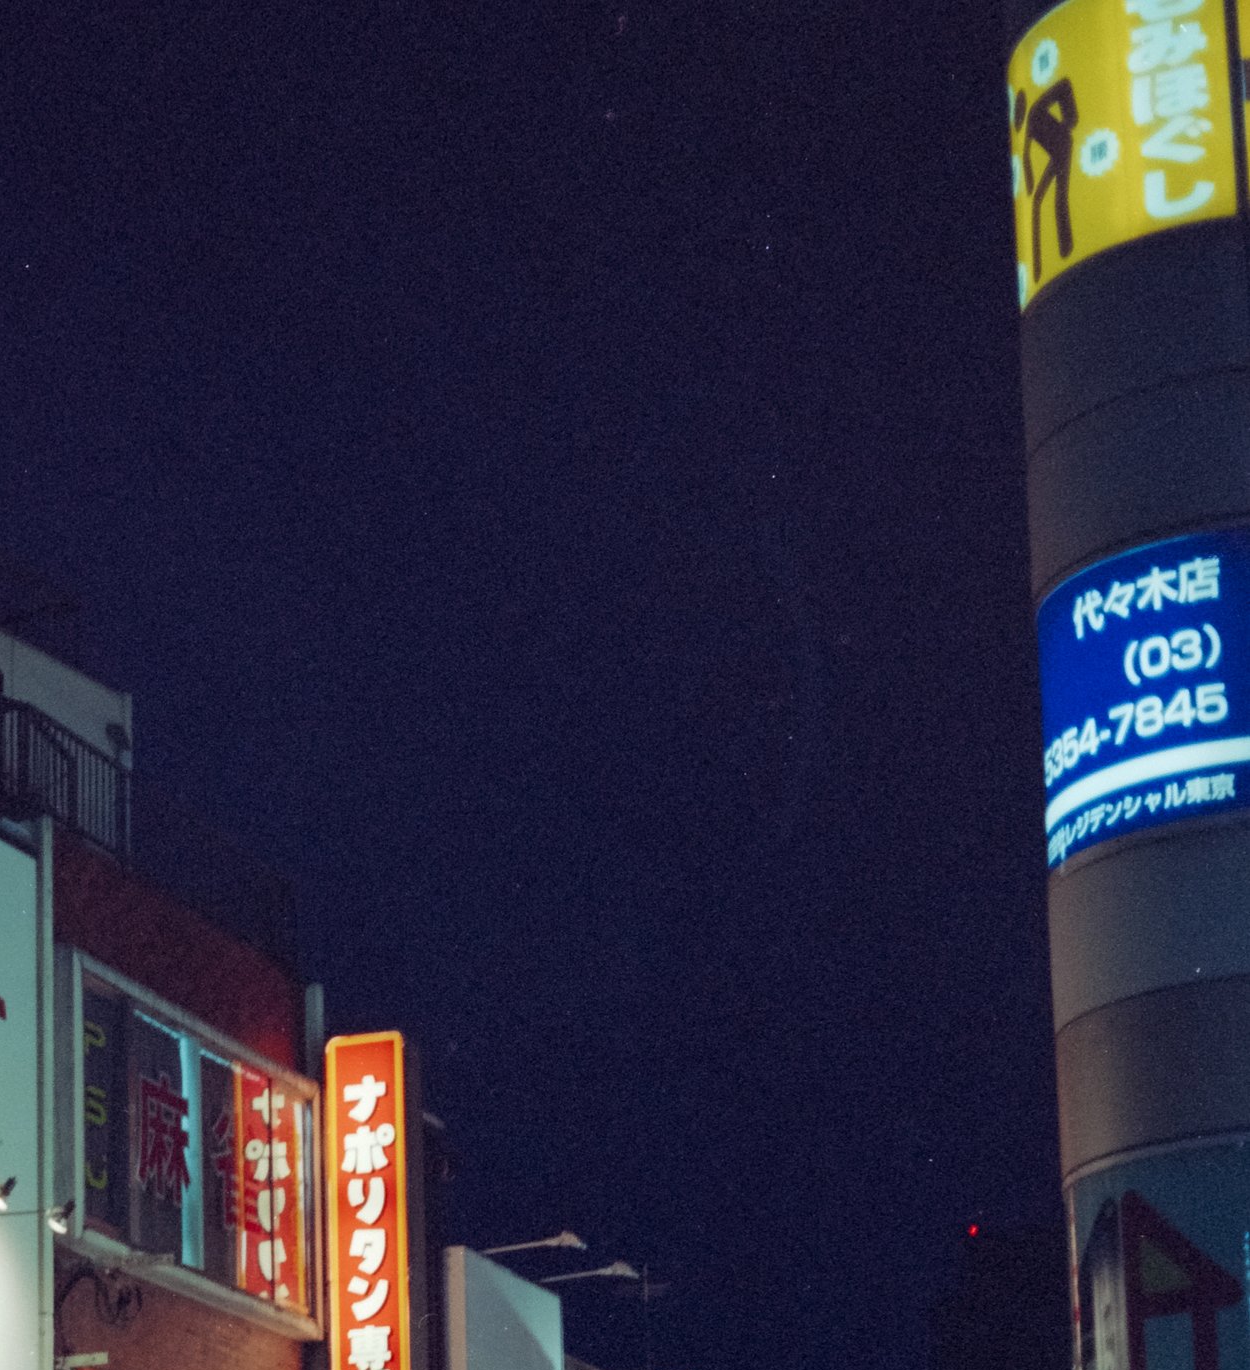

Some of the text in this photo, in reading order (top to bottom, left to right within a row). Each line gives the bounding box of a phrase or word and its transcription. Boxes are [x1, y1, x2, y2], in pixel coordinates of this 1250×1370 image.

[1073, 556, 1220, 640] 代々木店
[1124, 624, 1221, 686] (03)
